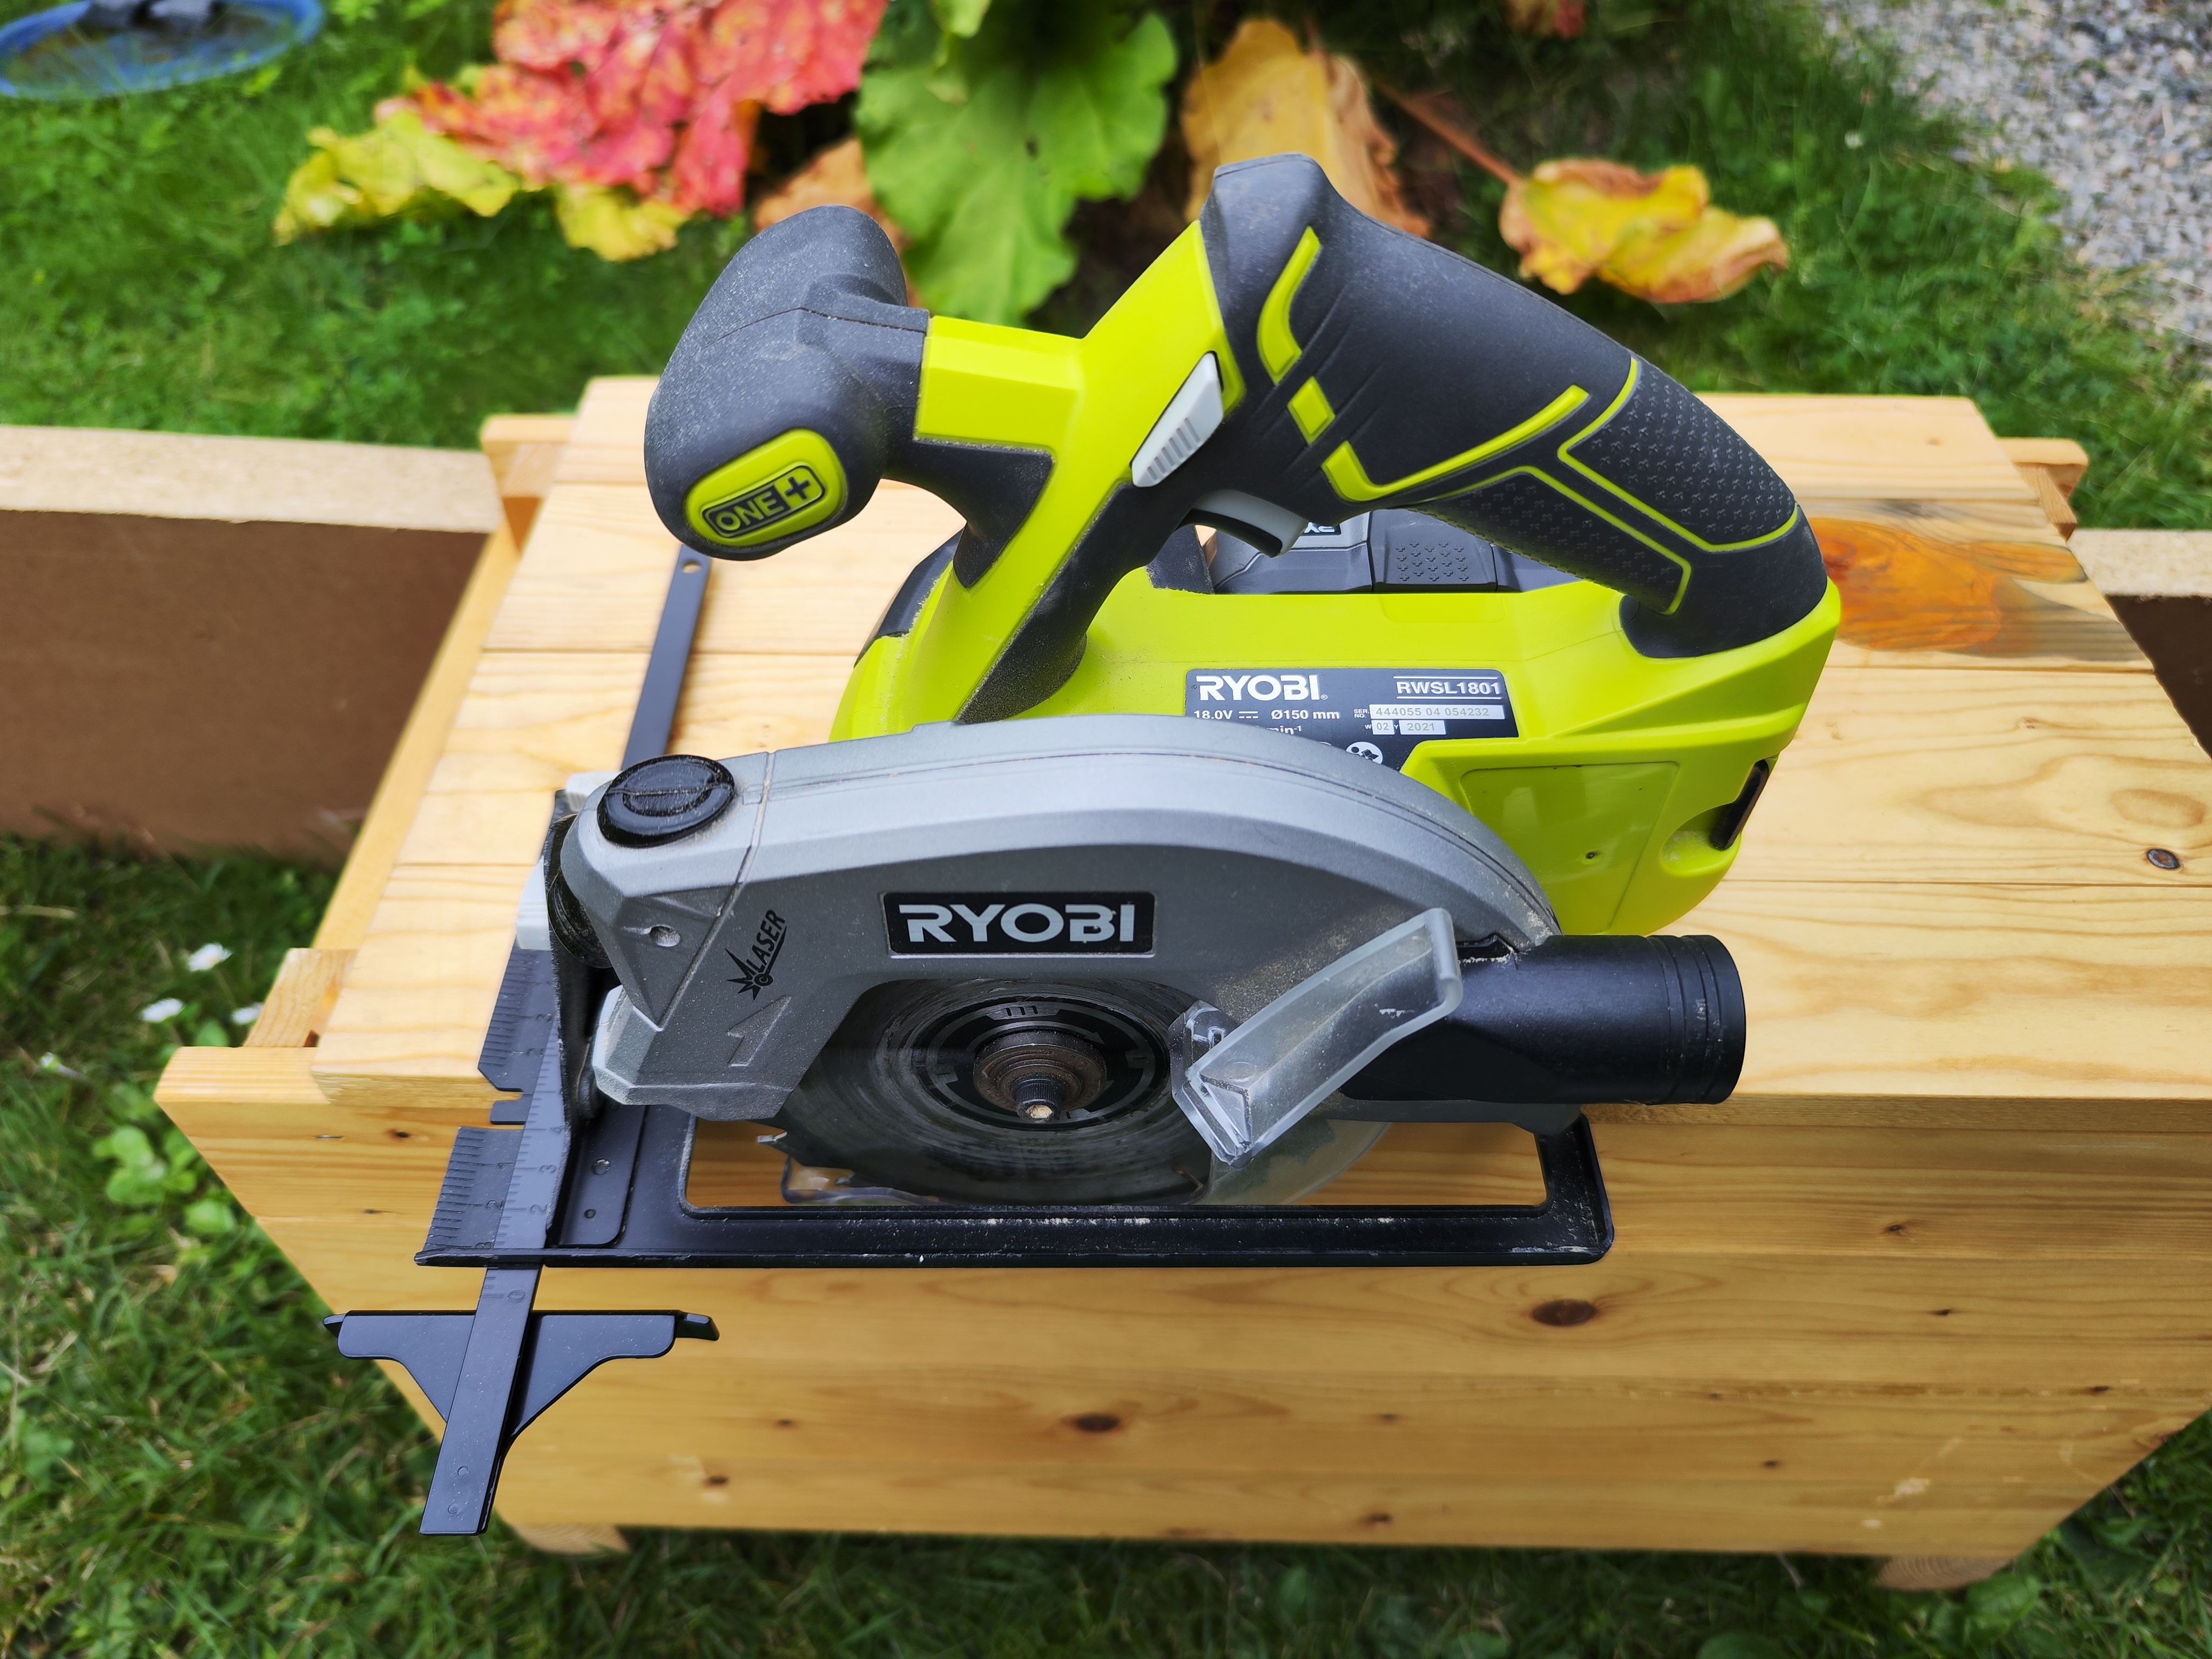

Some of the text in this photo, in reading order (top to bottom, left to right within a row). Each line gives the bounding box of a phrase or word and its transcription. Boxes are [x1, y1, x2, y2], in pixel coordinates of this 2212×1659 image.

[1397, 682, 1500, 694] RWSL1801
[1193, 709, 1233, 720] 18.0V
[1313, 711, 1340, 719] mm
[1375, 707, 1489, 717] 444055 04 054232
[1377, 722, 1389, 731] 02
[1407, 723, 1435, 731] 2021
[899, 903, 1135, 943] RYOBI
[746, 909, 785, 973] LASER
[486, 1200, 505, 1210] 2
[530, 1204, 548, 1214] 2
